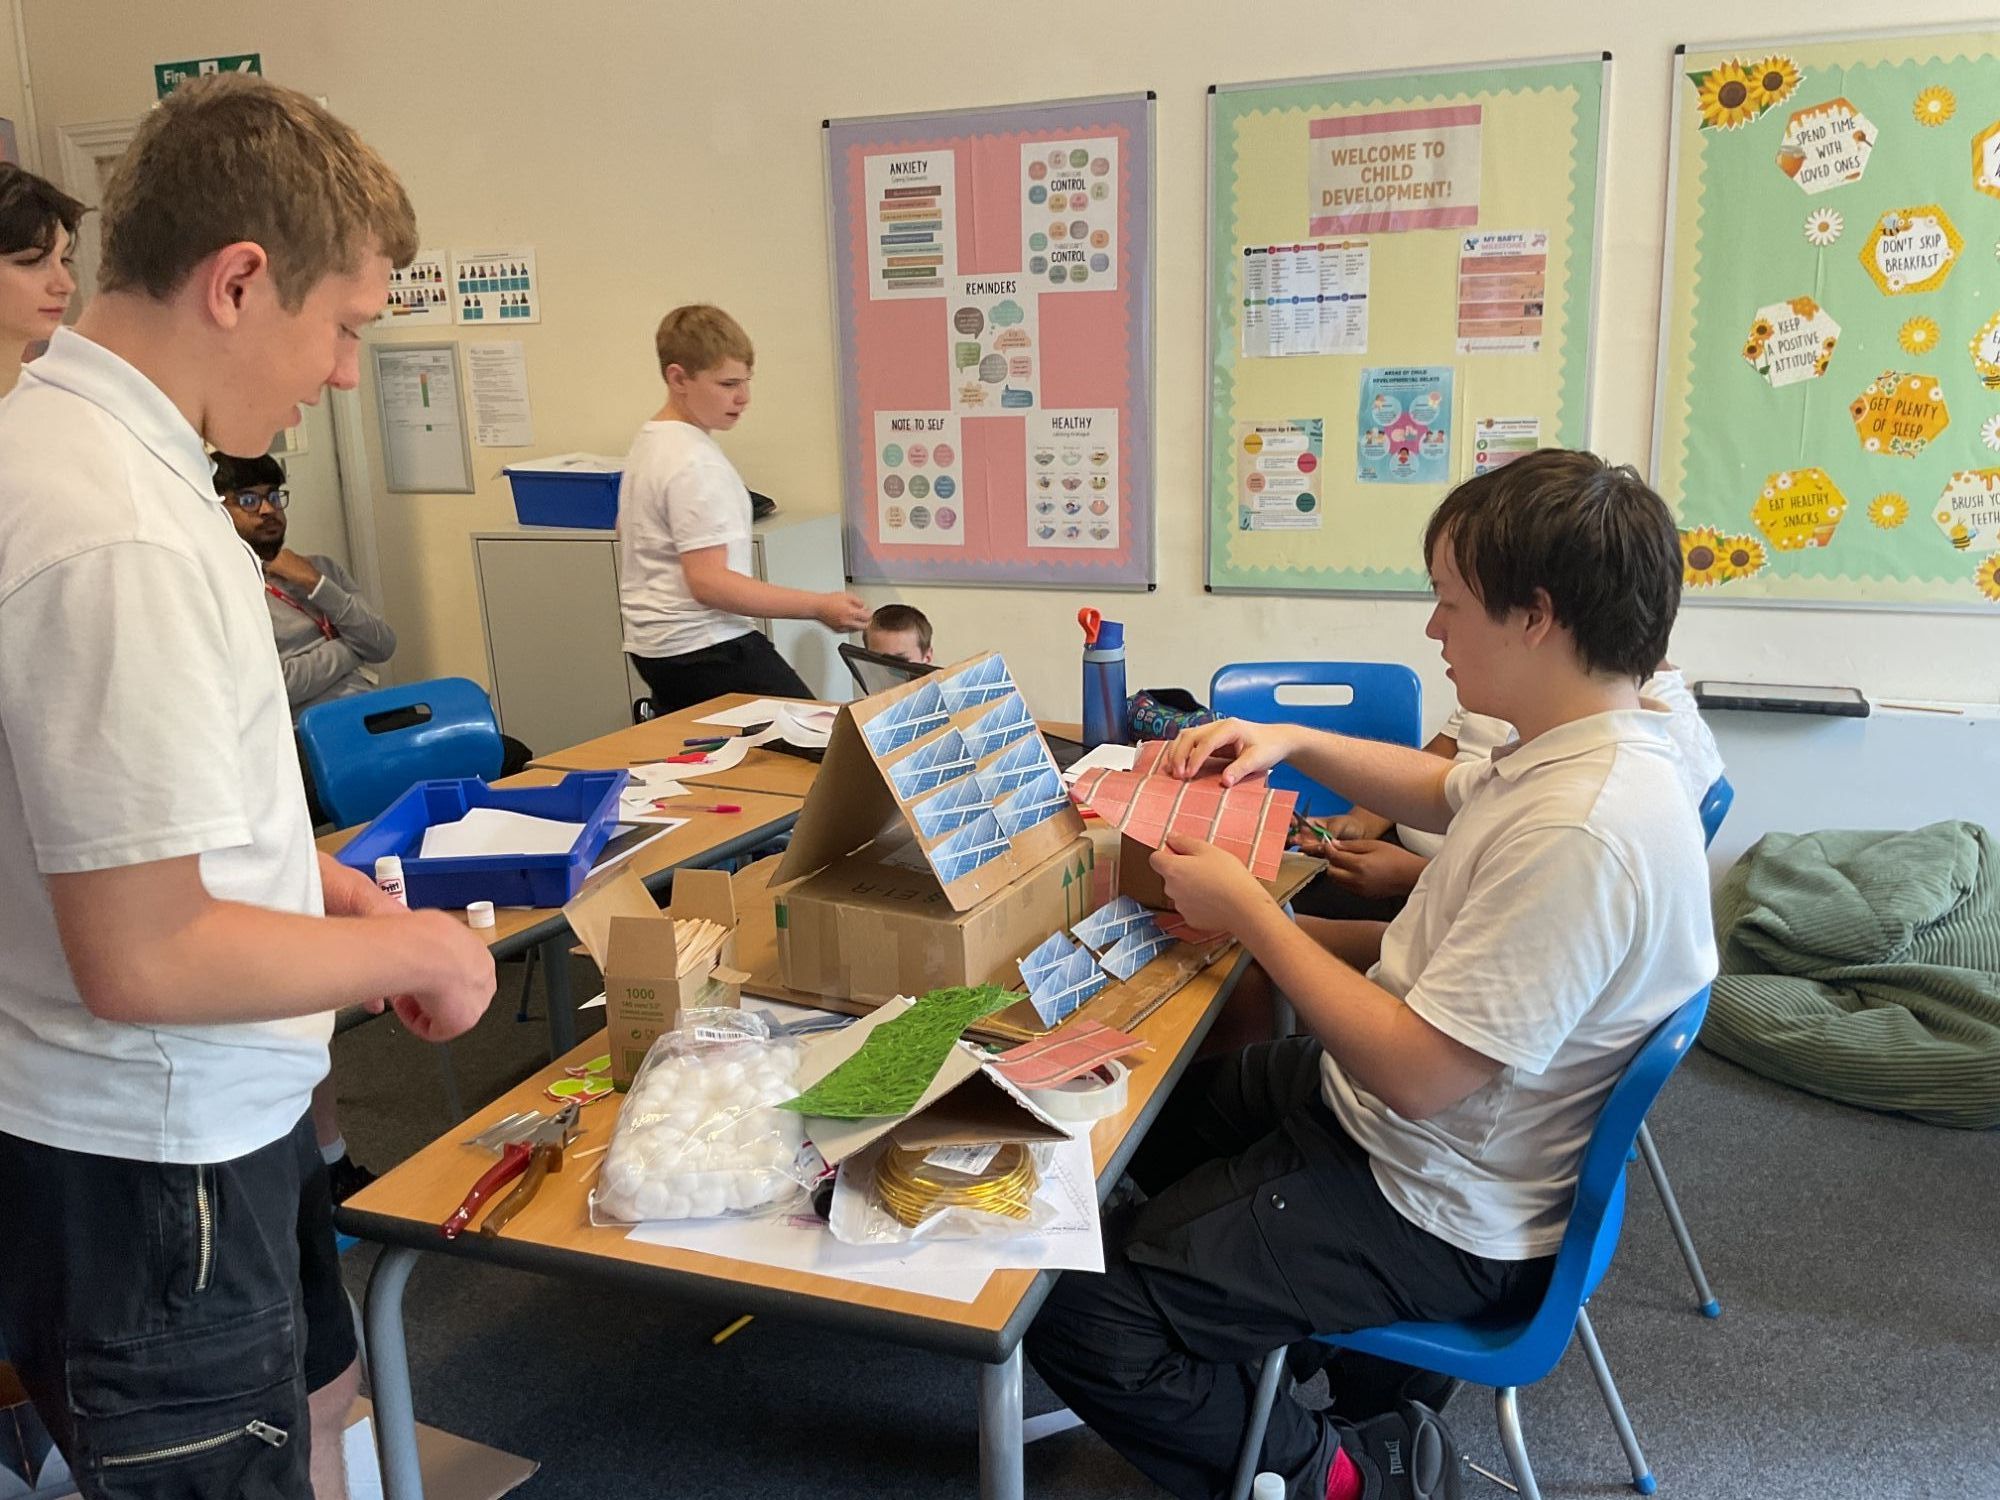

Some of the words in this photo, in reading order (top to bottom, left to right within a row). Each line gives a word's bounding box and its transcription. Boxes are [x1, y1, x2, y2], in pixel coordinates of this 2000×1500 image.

[1796, 126, 1826, 146] SPEND
[1831, 117, 1856, 134] TIME
[1331, 143, 1416, 166] WELCOME
[1422, 141, 1445, 158] TO
[1816, 141, 1842, 159] WITH
[890, 160, 927, 175] ANXIETY
[1361, 164, 1413, 183] CHILD
[1800, 164, 1830, 184] LOVED
[1834, 156, 1860, 173] ONES
[1051, 178, 1086, 192] CONTROL
[1322, 180, 1452, 207] DEVELOPMENT!
[1883, 237, 1912, 253] DON'T
[1920, 233, 1941, 249] SKIP
[1051, 250, 1086, 263] CONTROL
[1885, 253, 1939, 273] BREAKFAST
[965, 281, 1017, 295] REMINDERS
[1778, 317, 1800, 335] KEEP
[1767, 343, 1774, 356] A
[1778, 331, 1820, 354] POSITIVE
[1775, 350, 1817, 373] ATTITUDE
[1869, 397, 1890, 411] GET
[1895, 400, 1938, 420] PLENTY
[891, 419, 911, 431] NOTE
[915, 419, 924, 431] TO
[927, 418, 944, 430] SELF
[1052, 416, 1092, 429] HEALTHY
[1873, 418, 1885, 432] OF
[1890, 422, 1923, 440] SLEEP
[1769, 498, 1784, 512] EAT
[1790, 492, 1829, 509] HEALTHY
[1951, 494, 1984, 510] BRUSH
[1783, 512, 1819, 528] SNACKS
[1970, 511, 2000, 525] TEETH
[626, 988, 655, 1000] 1000
